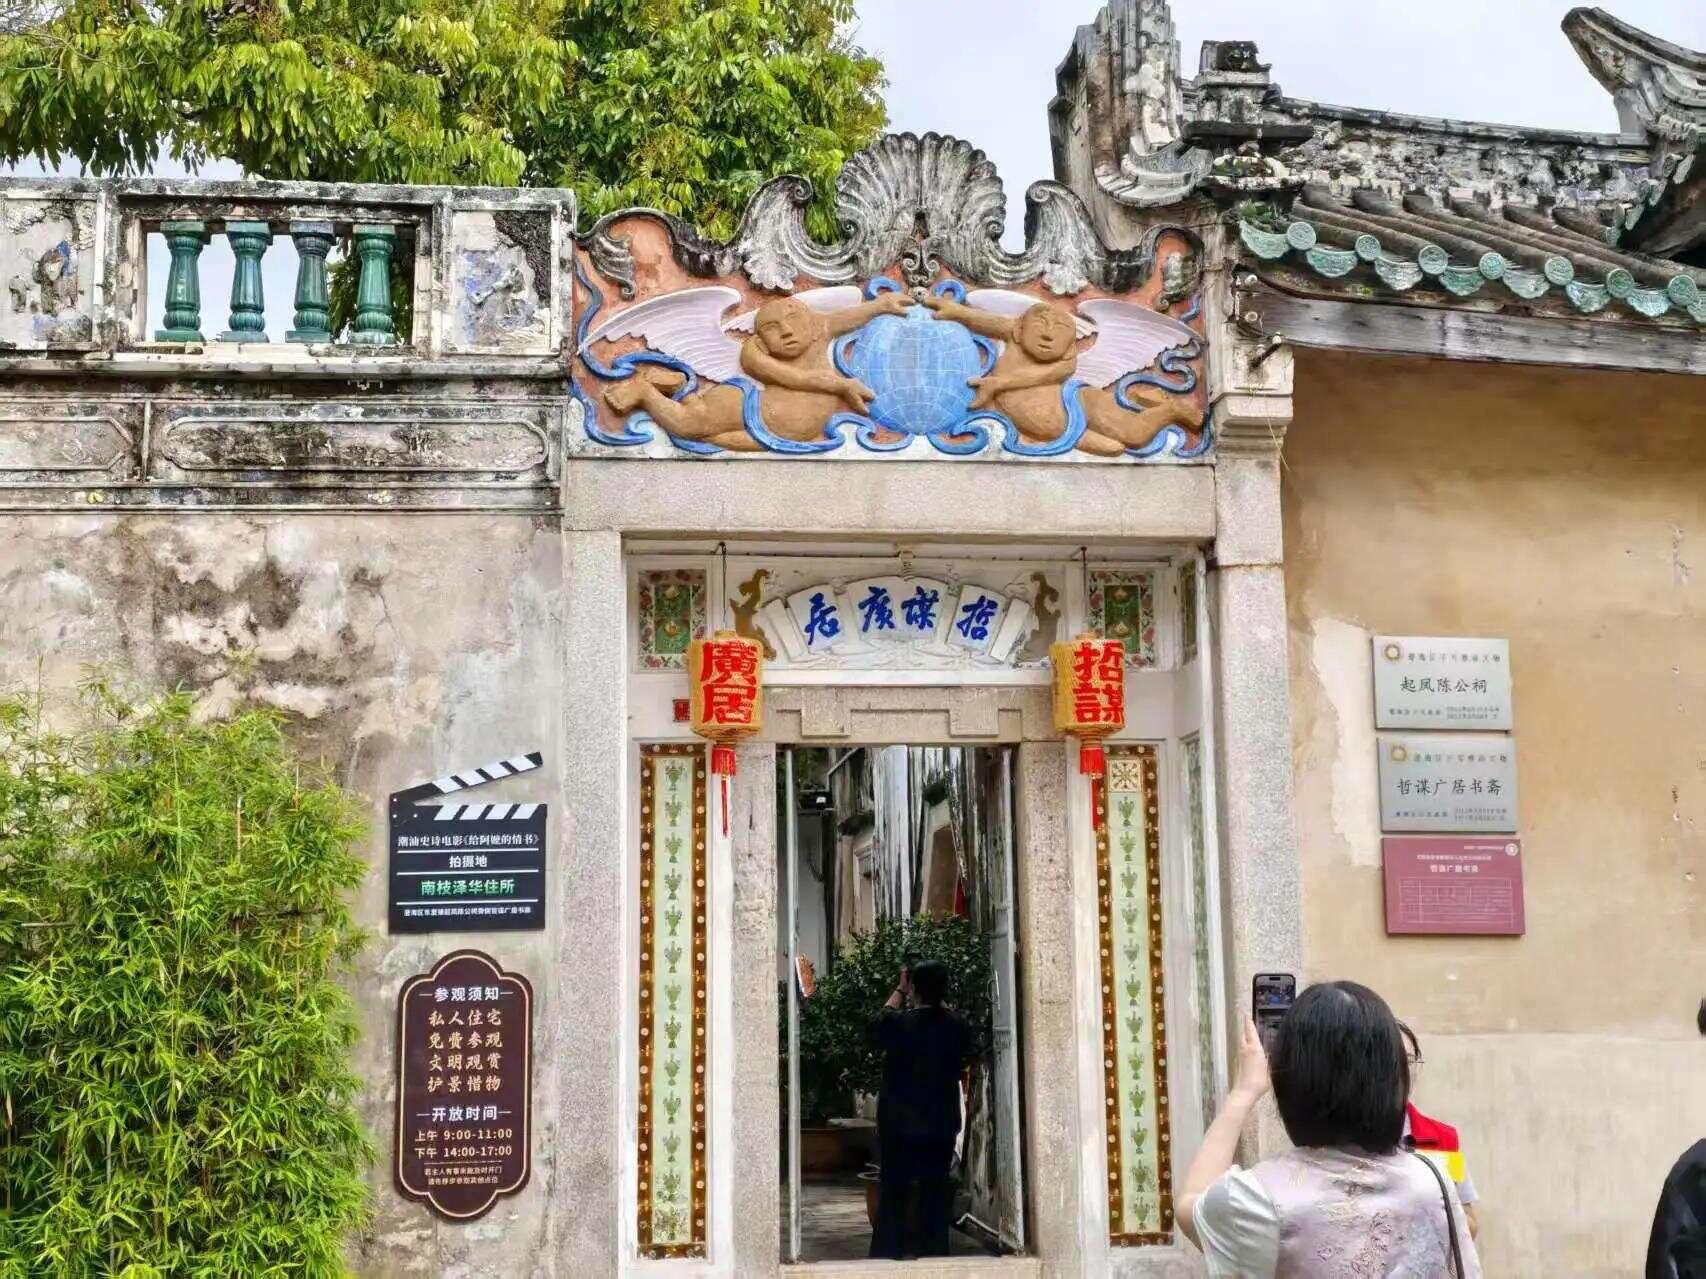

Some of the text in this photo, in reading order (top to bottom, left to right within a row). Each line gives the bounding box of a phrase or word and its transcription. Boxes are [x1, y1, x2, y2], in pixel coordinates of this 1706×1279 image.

[700, 640, 759, 724] 廣居
[1073, 640, 1126, 724] 哲謀
[1400, 676, 1487, 693] 起凤陈公祠
[1397, 778, 1501, 796] 哲谋广居书斋
[449, 855, 488, 868] 拍摄地
[421, 879, 515, 896] 南枝泽华住所
[434, 986, 499, 1002] 参观须知
[428, 1008, 502, 1027] 私人住宅
[428, 1031, 503, 1049] 免费参观
[429, 1052, 502, 1071] 文明观赏
[428, 1075, 501, 1093] 护景惜物
[432, 1105, 498, 1122] 开放时间
[415, 1128, 513, 1142] 上午 9:00-11:00
[414, 1145, 513, 1160] 下午 14:00-17:00
